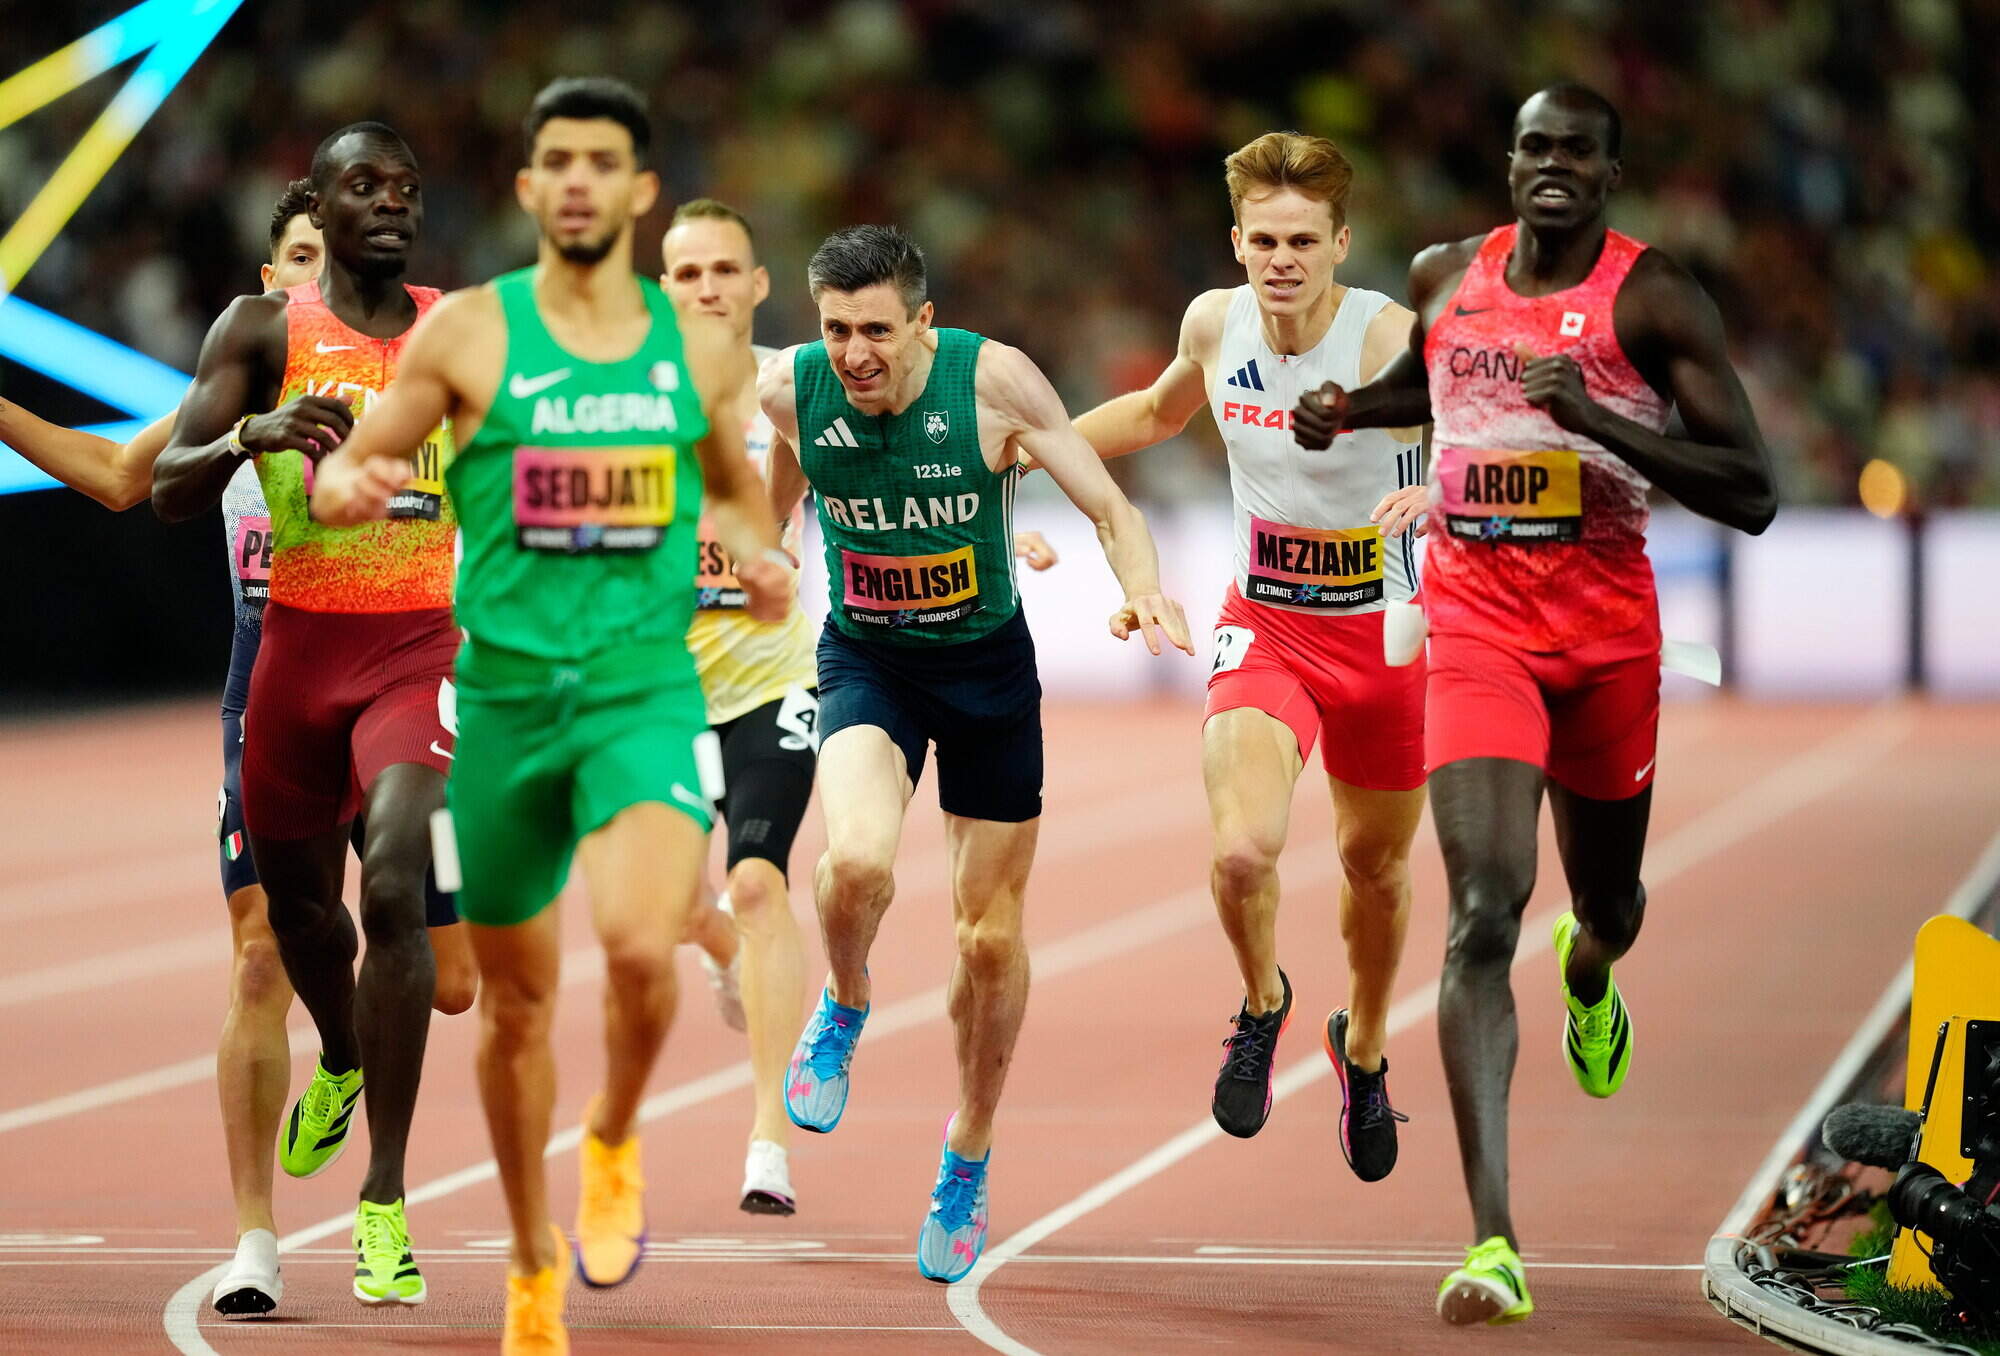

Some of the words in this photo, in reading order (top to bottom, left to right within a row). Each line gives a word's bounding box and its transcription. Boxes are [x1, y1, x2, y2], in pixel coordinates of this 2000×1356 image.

[533, 393, 677, 434] ALGERIA
[527, 468, 664, 509] SEDJATI
[913, 463, 963, 479] 123.ie
[1464, 464, 1549, 504] AROP
[824, 492, 980, 531] IRELAND
[1257, 531, 1377, 576] MEZIANE
[850, 558, 970, 601] ENGLISH
[1256, 583, 1293, 599] ULTIMATE
[1321, 589, 1364, 602] BUDAPEST
[851, 611, 890, 625] ULTIMATE
[918, 608, 961, 624] BUDAPEST
